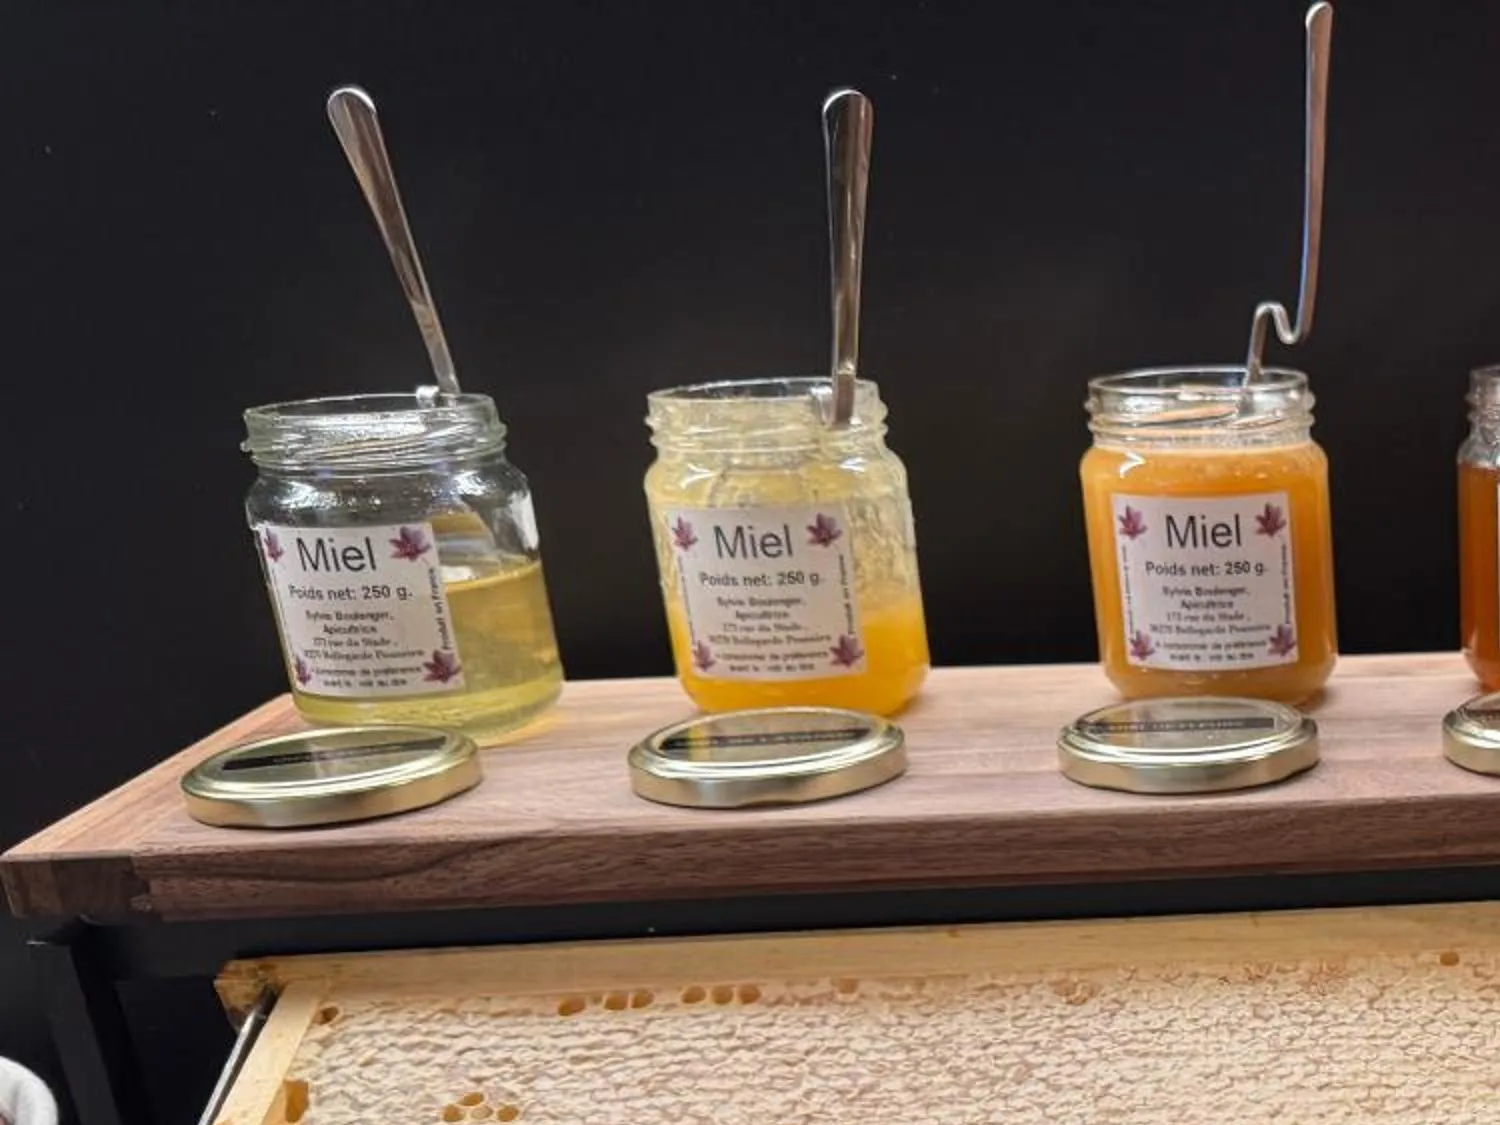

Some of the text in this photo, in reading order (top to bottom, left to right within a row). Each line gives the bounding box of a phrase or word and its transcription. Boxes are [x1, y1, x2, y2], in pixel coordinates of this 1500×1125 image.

[714, 524, 793, 559] Miel
[1165, 513, 1241, 548] Miel
[296, 536, 377, 572] Miel
[701, 573, 739, 586] Poids
[743, 573, 773, 586] net:
[777, 572, 805, 585] 250
[1145, 561, 1186, 576] Poids
[1191, 562, 1220, 576] net:
[1224, 560, 1250, 575] 250
[288, 584, 323, 600] Poids
[328, 586, 357, 600] net:
[362, 585, 391, 599] 250
